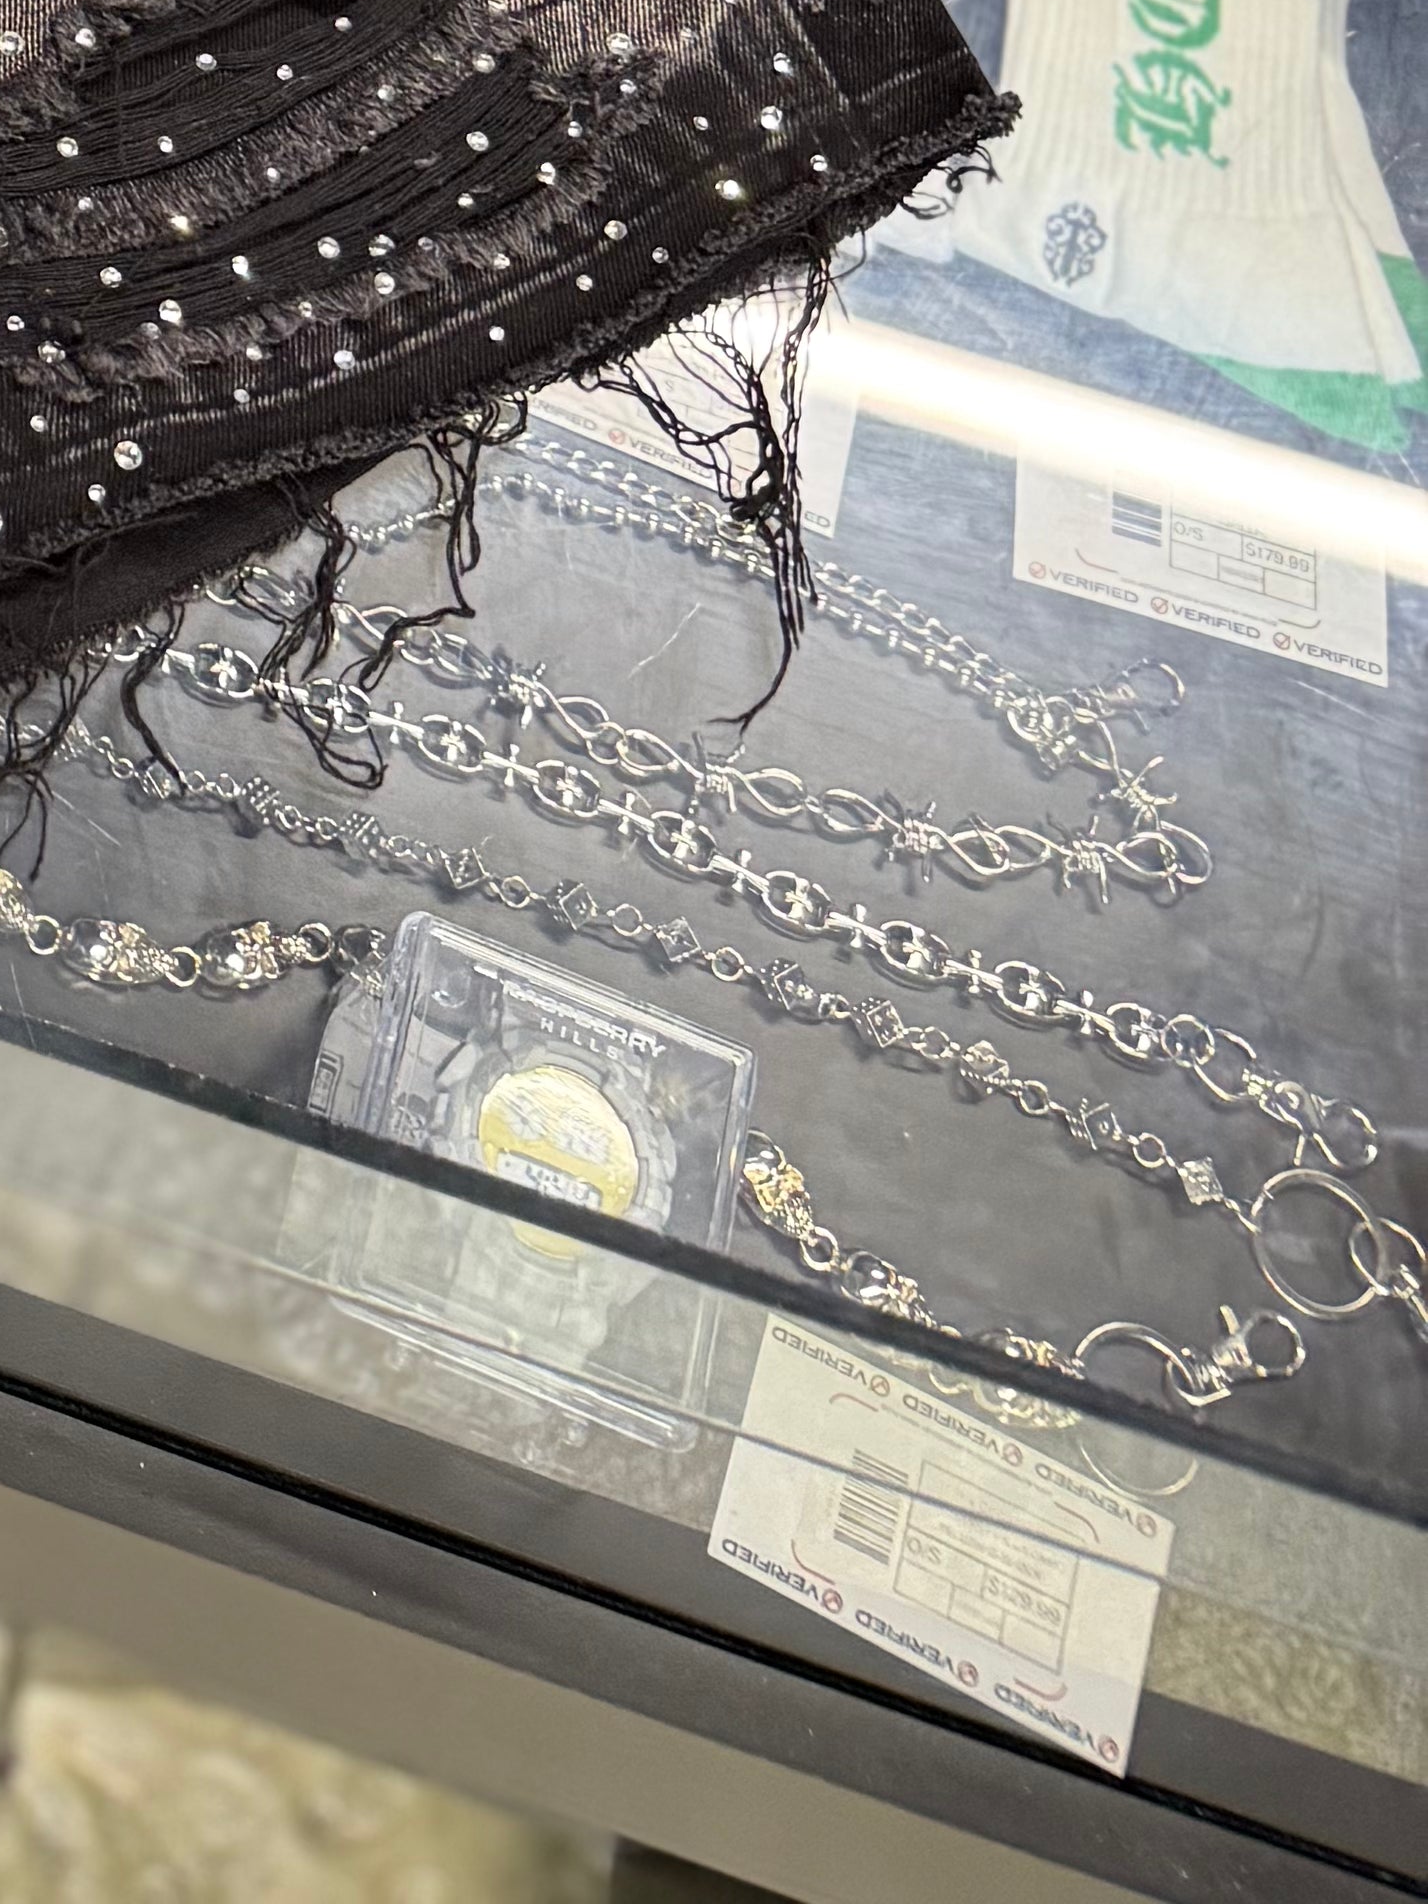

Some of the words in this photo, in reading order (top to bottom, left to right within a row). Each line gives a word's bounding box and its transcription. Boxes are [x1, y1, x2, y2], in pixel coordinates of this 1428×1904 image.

[1049, 568, 1140, 604] VERIFIED
[1171, 603, 1262, 640] VERIFIED
[1293, 638, 1384, 677] VERIFIED
[540, 1016, 619, 1060] HILLS
[771, 1325, 868, 1390] VERIFIED
[902, 1393, 1001, 1459] VERIFIED
[1034, 1461, 1135, 1525] VERIFIED
[721, 1537, 821, 1602] VERIFIED
[855, 1607, 956, 1676] VERIFIED
